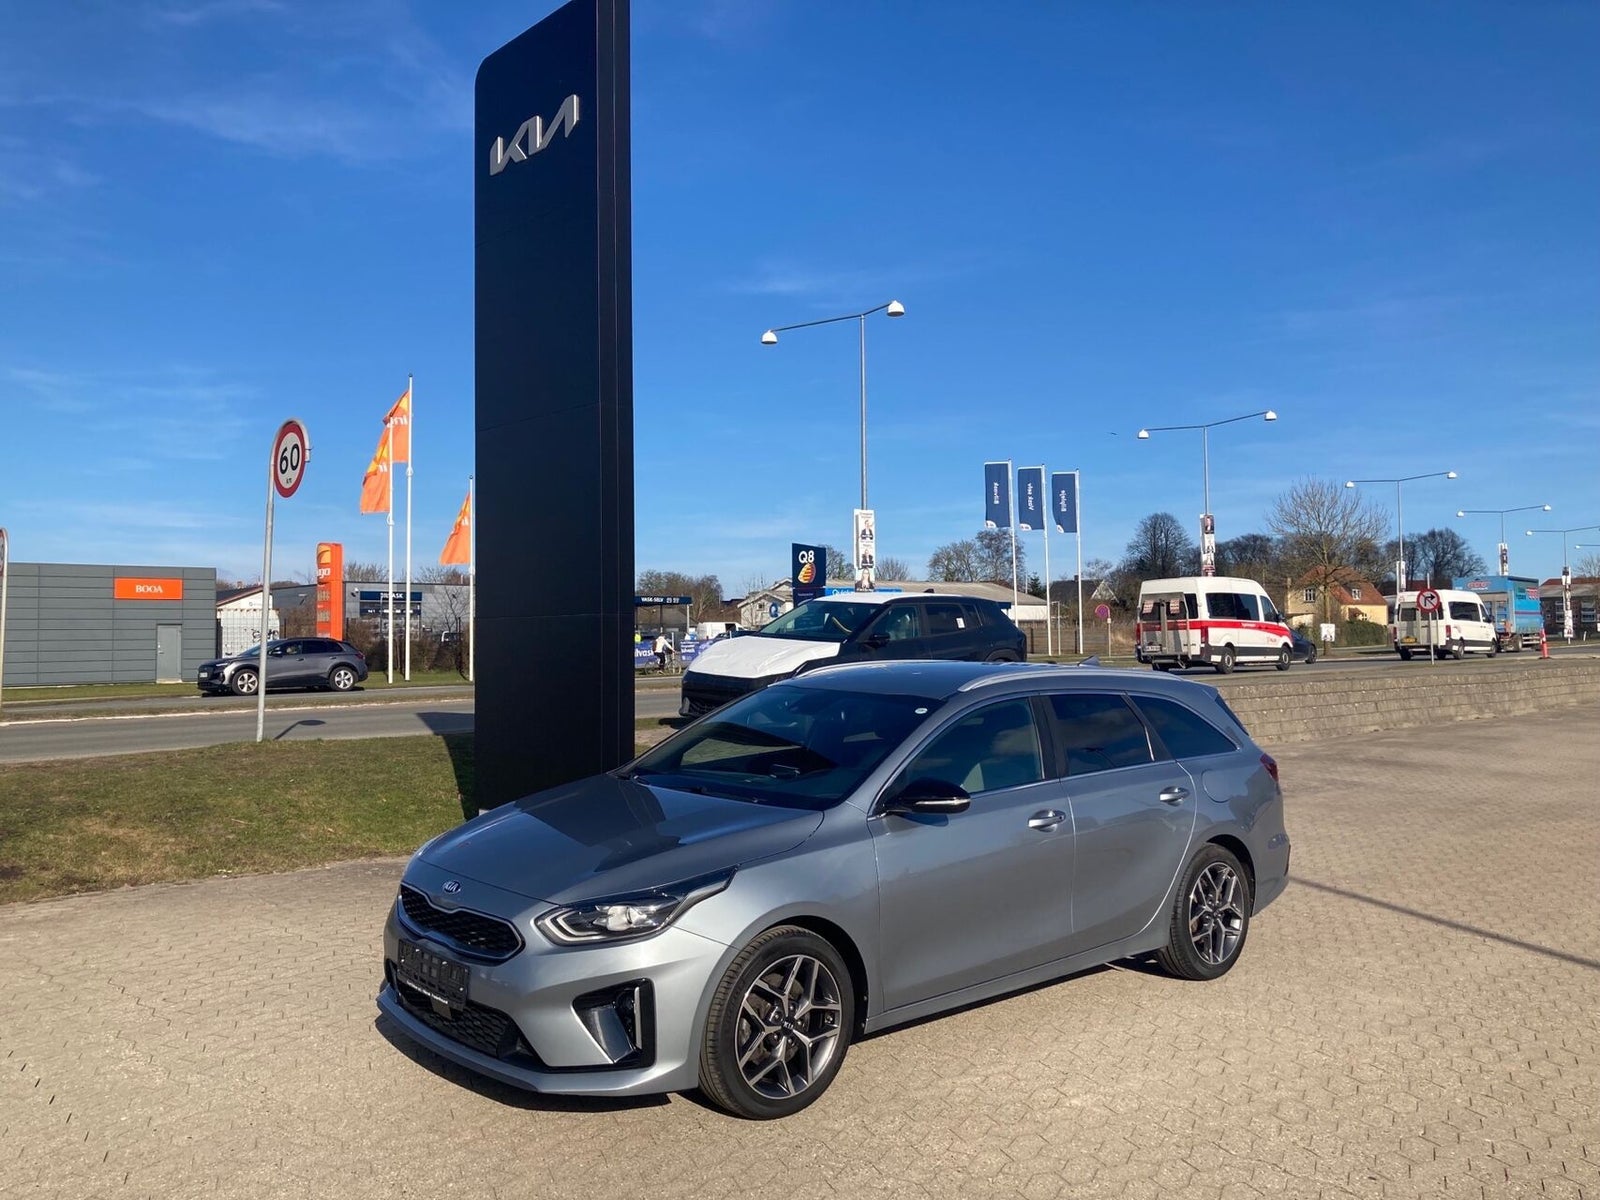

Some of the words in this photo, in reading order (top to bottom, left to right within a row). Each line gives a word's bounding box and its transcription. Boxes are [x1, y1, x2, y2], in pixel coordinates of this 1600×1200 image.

[489, 94, 580, 176] KIA
[280, 443, 300, 475] 60
[798, 550, 815, 563] Q8
[135, 585, 163, 593] BOOA
